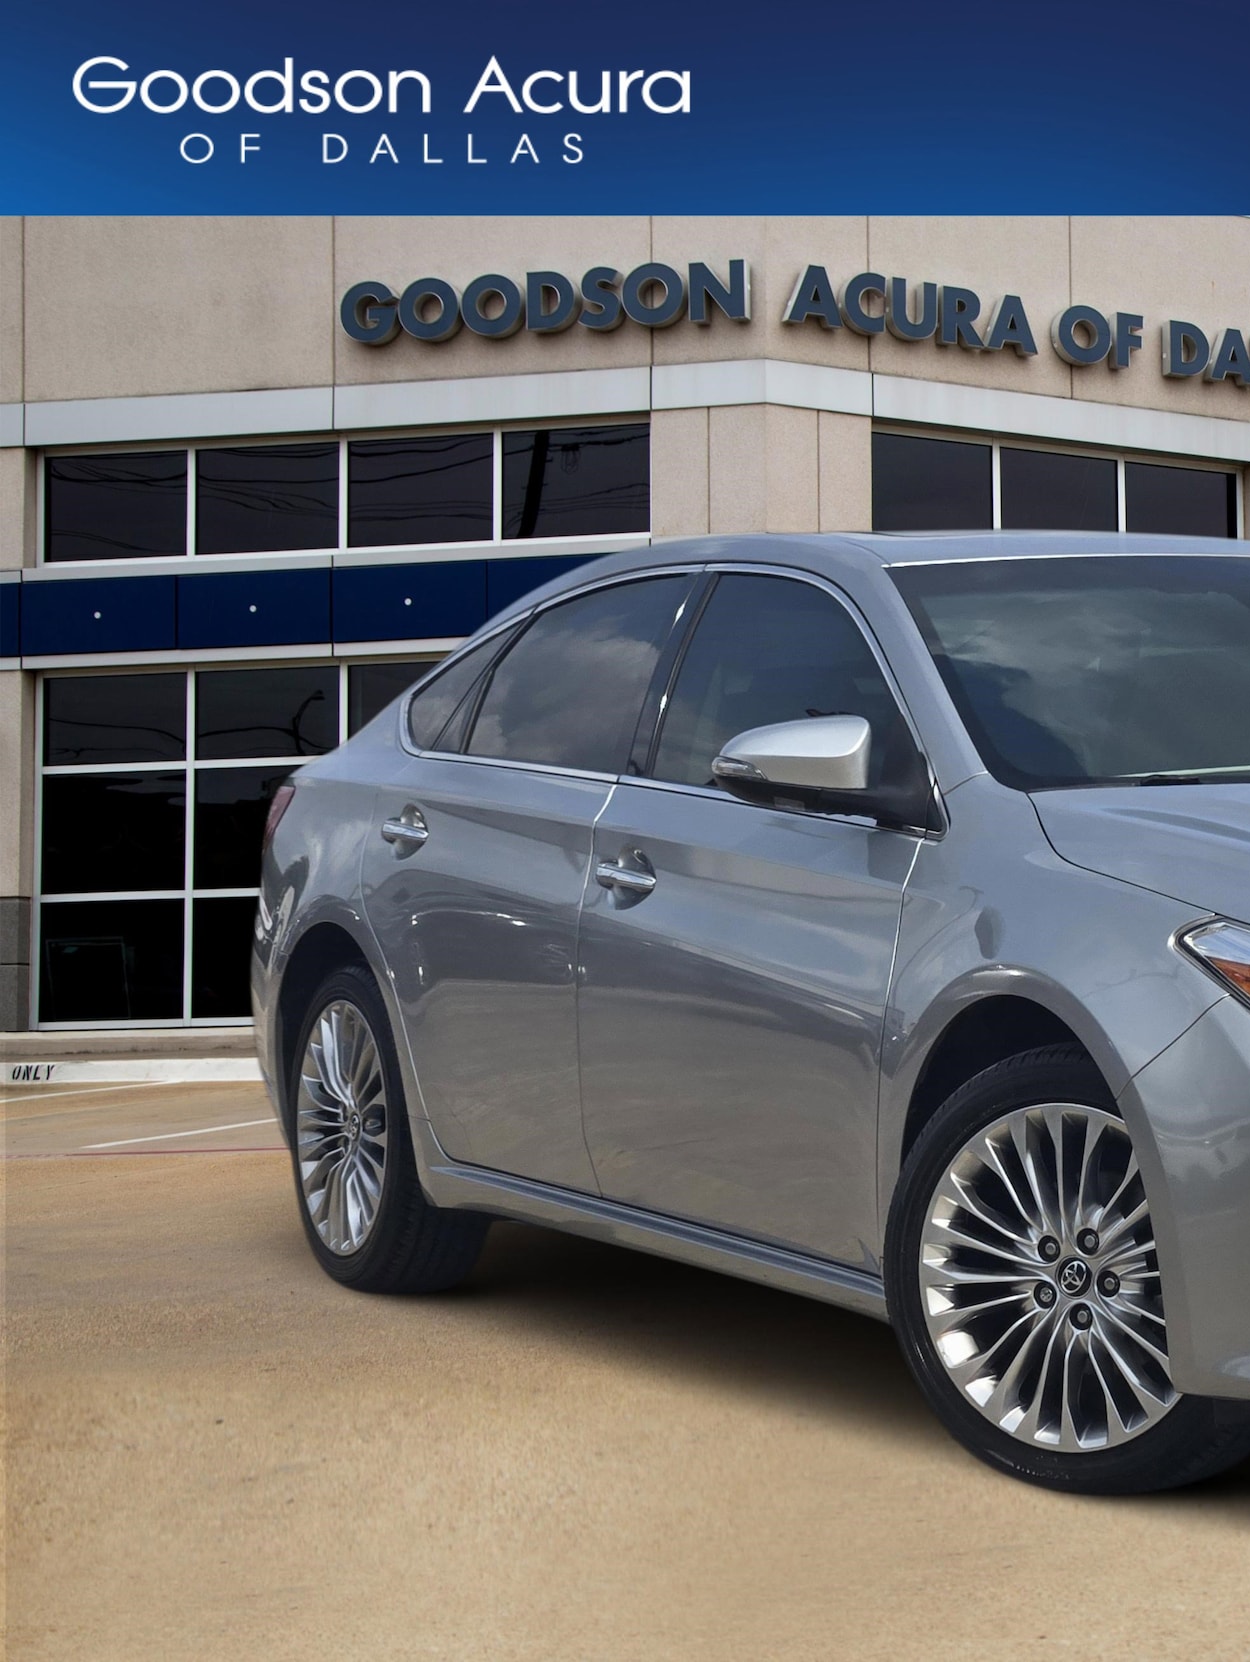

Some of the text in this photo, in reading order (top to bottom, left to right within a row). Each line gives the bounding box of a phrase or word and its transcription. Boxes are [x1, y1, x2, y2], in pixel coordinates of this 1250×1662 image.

[340, 259, 752, 347] GOODSON
[782, 264, 1038, 356] ACURA
[1051, 305, 1144, 370] OF
[12, 1064, 55, 1081] ONLY
